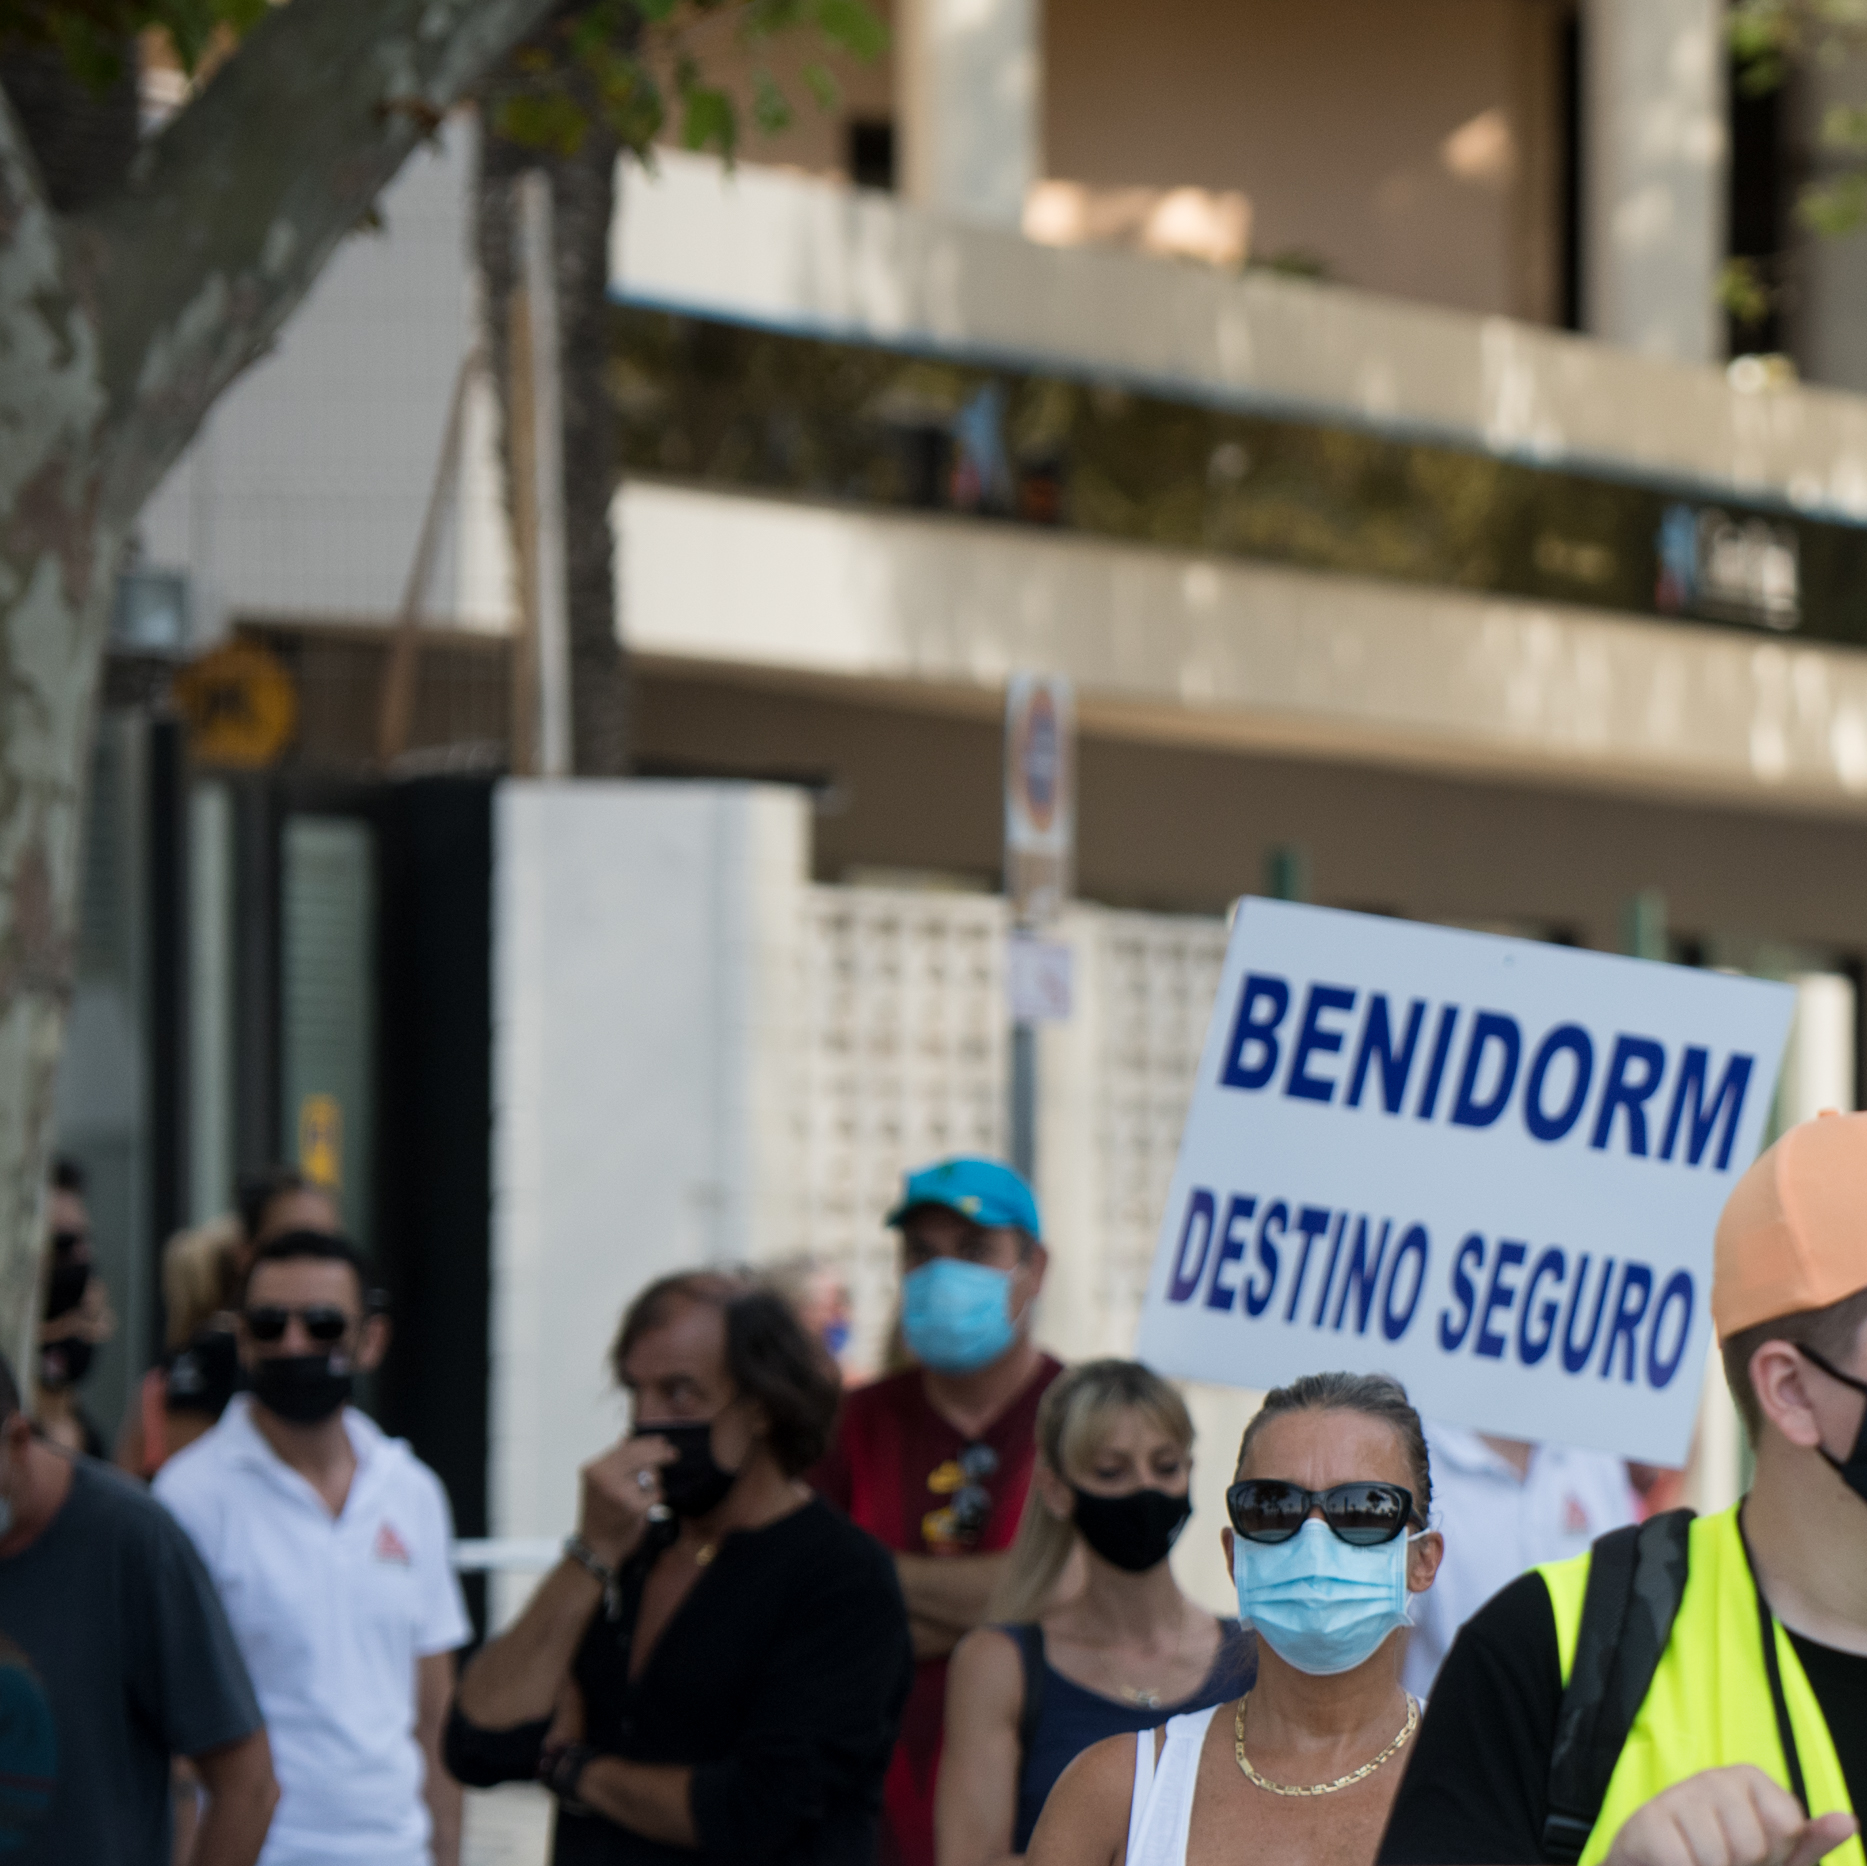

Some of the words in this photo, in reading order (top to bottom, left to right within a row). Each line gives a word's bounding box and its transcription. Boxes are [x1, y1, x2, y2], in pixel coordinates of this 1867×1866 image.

[1217, 970, 1756, 1174] BENIDORM
[1166, 1185, 1430, 1342] DESTINO
[1435, 1230, 1695, 1391] SEGURO
